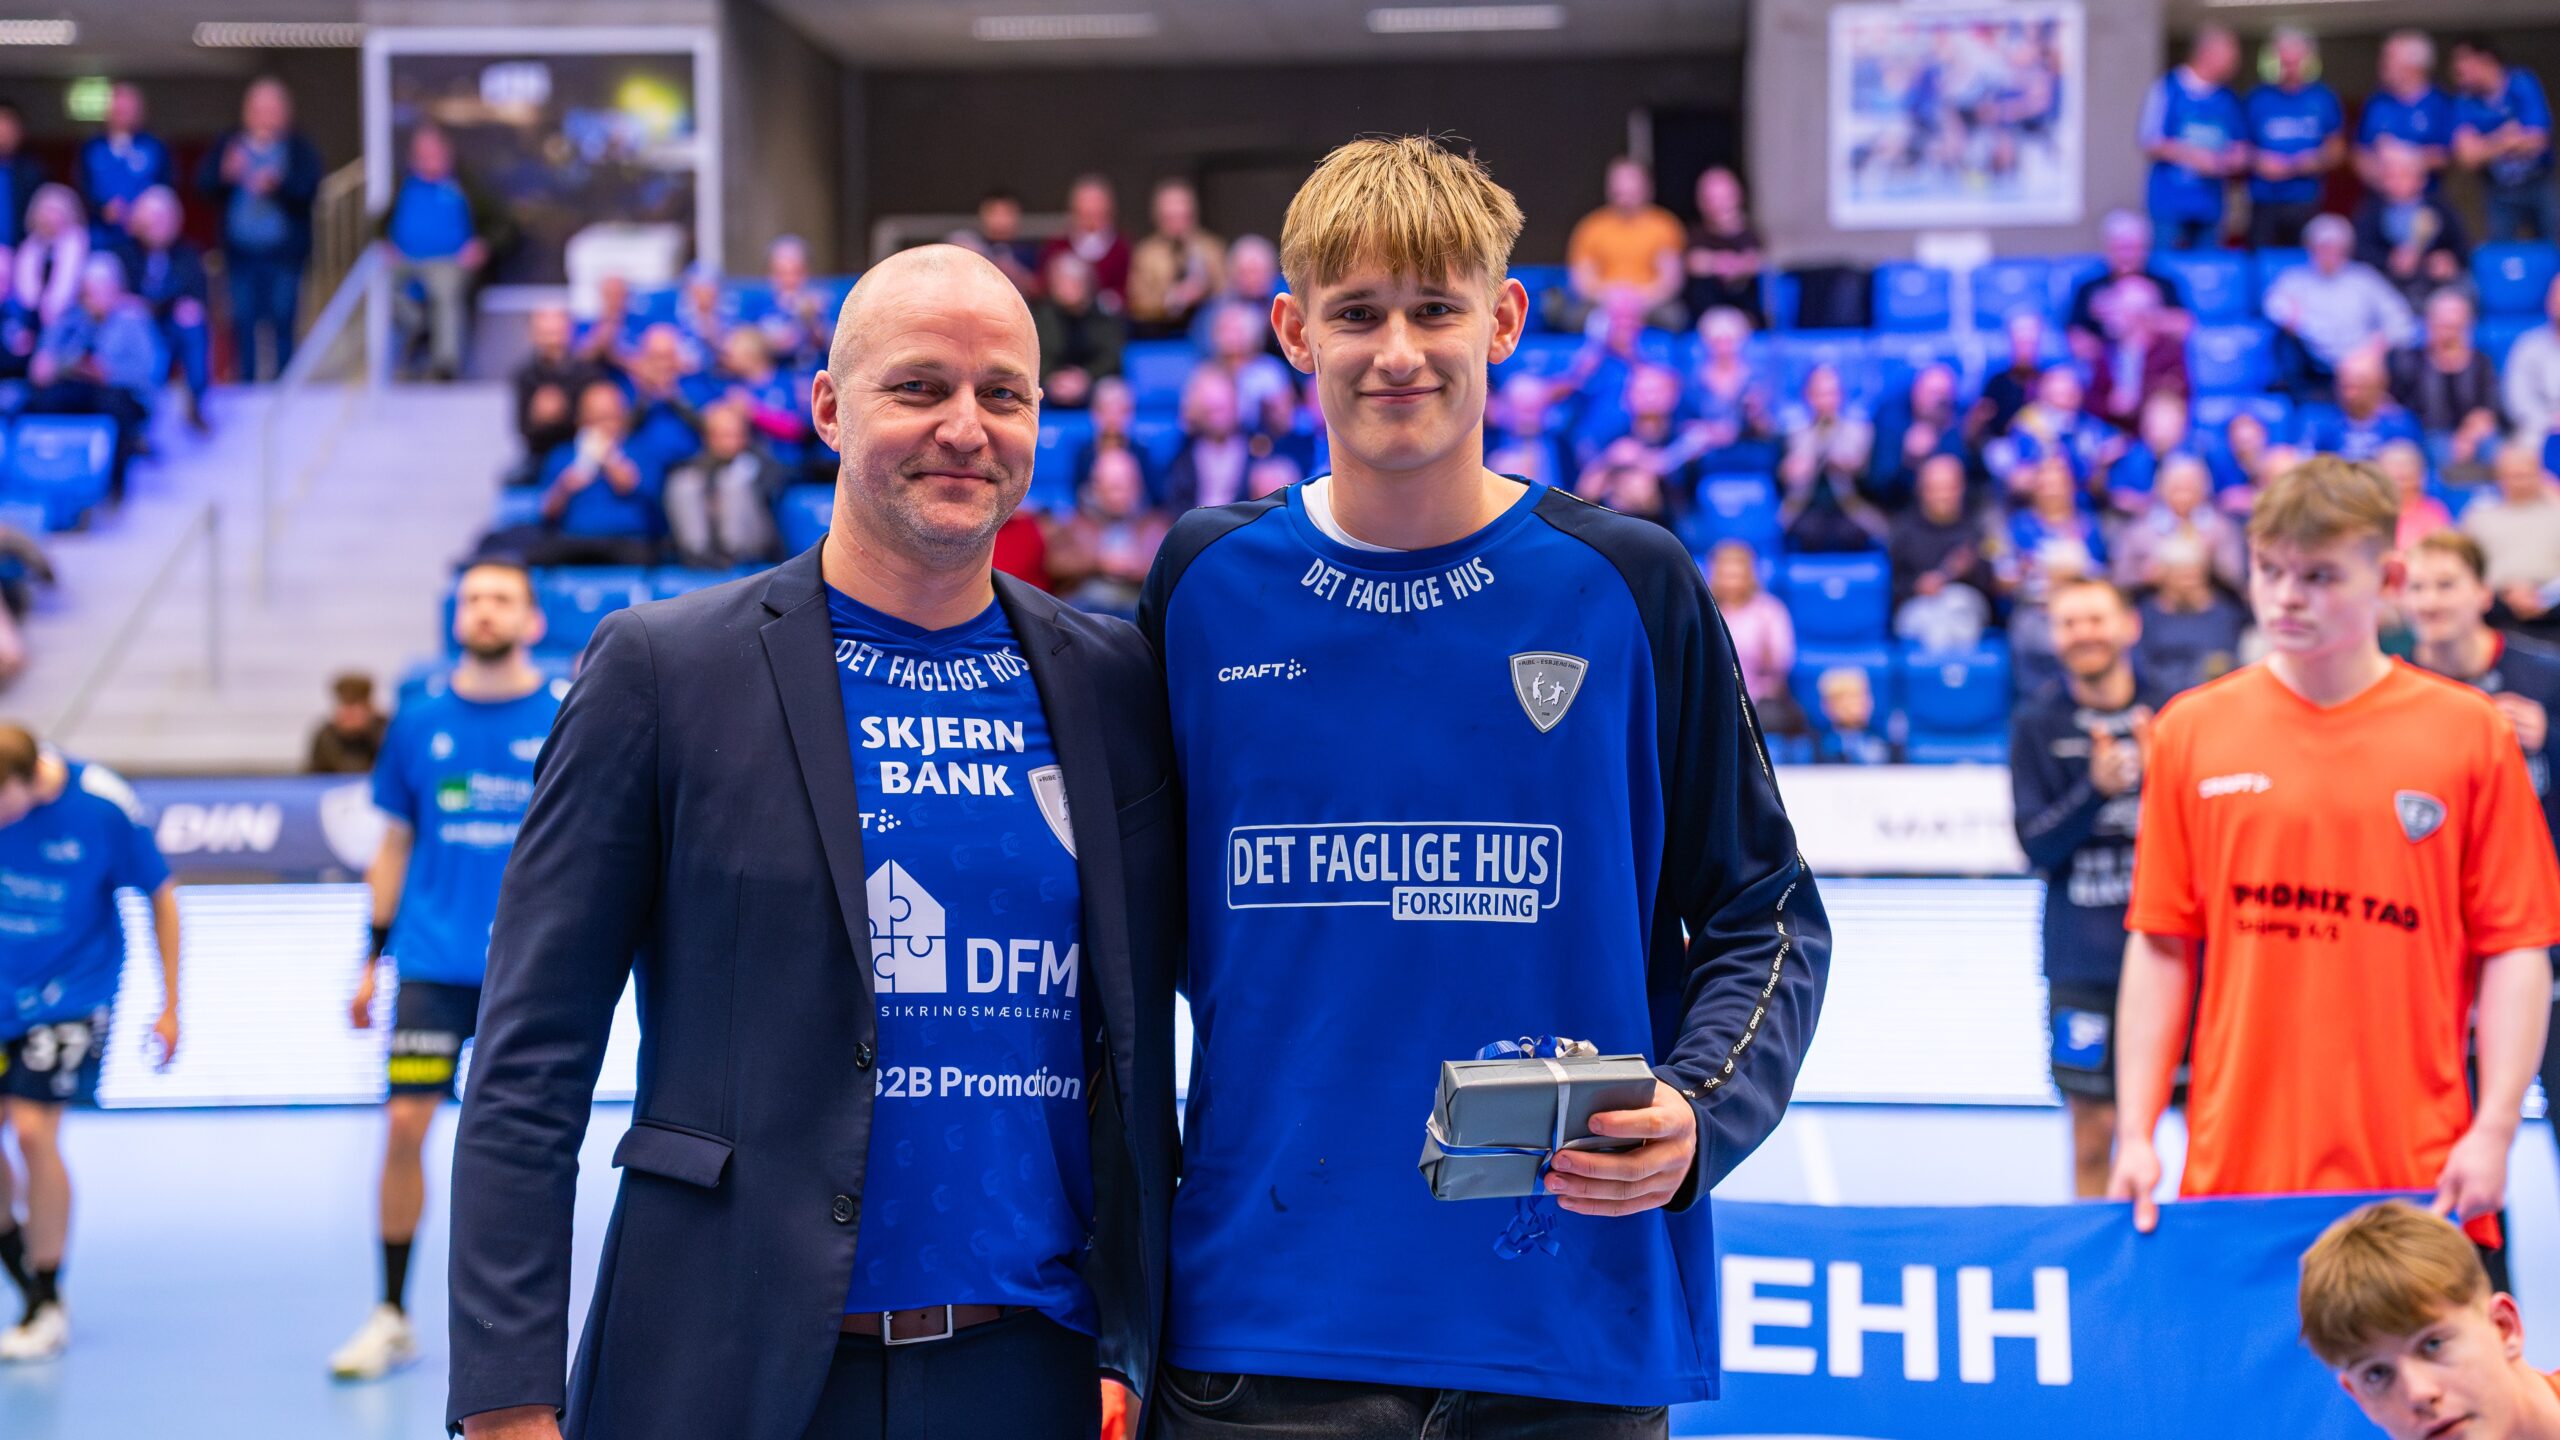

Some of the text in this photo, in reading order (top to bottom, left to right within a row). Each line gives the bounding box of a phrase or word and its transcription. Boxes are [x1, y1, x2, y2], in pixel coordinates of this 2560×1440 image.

[1300, 556, 1496, 613] DET FAGLIGE HUS
[834, 638, 1031, 692] DET FAGLIGE HUS
[1217, 661, 1286, 682] CRAFT
[860, 716, 1026, 756] SKJERN
[879, 760, 1015, 797] BANK
[1233, 832, 1550, 886] DET FAGLIGE HUS
[1396, 891, 1534, 918] FORSIKRING
[1776, 887, 1793, 911] CRAFT
[966, 938, 1080, 998] DFM
[1773, 949, 1787, 971] CRAFT
[1764, 972, 1779, 997] CRAFT
[1749, 1009, 1763, 1030] CRAFT
[940, 1066, 1081, 1100] Promotion
